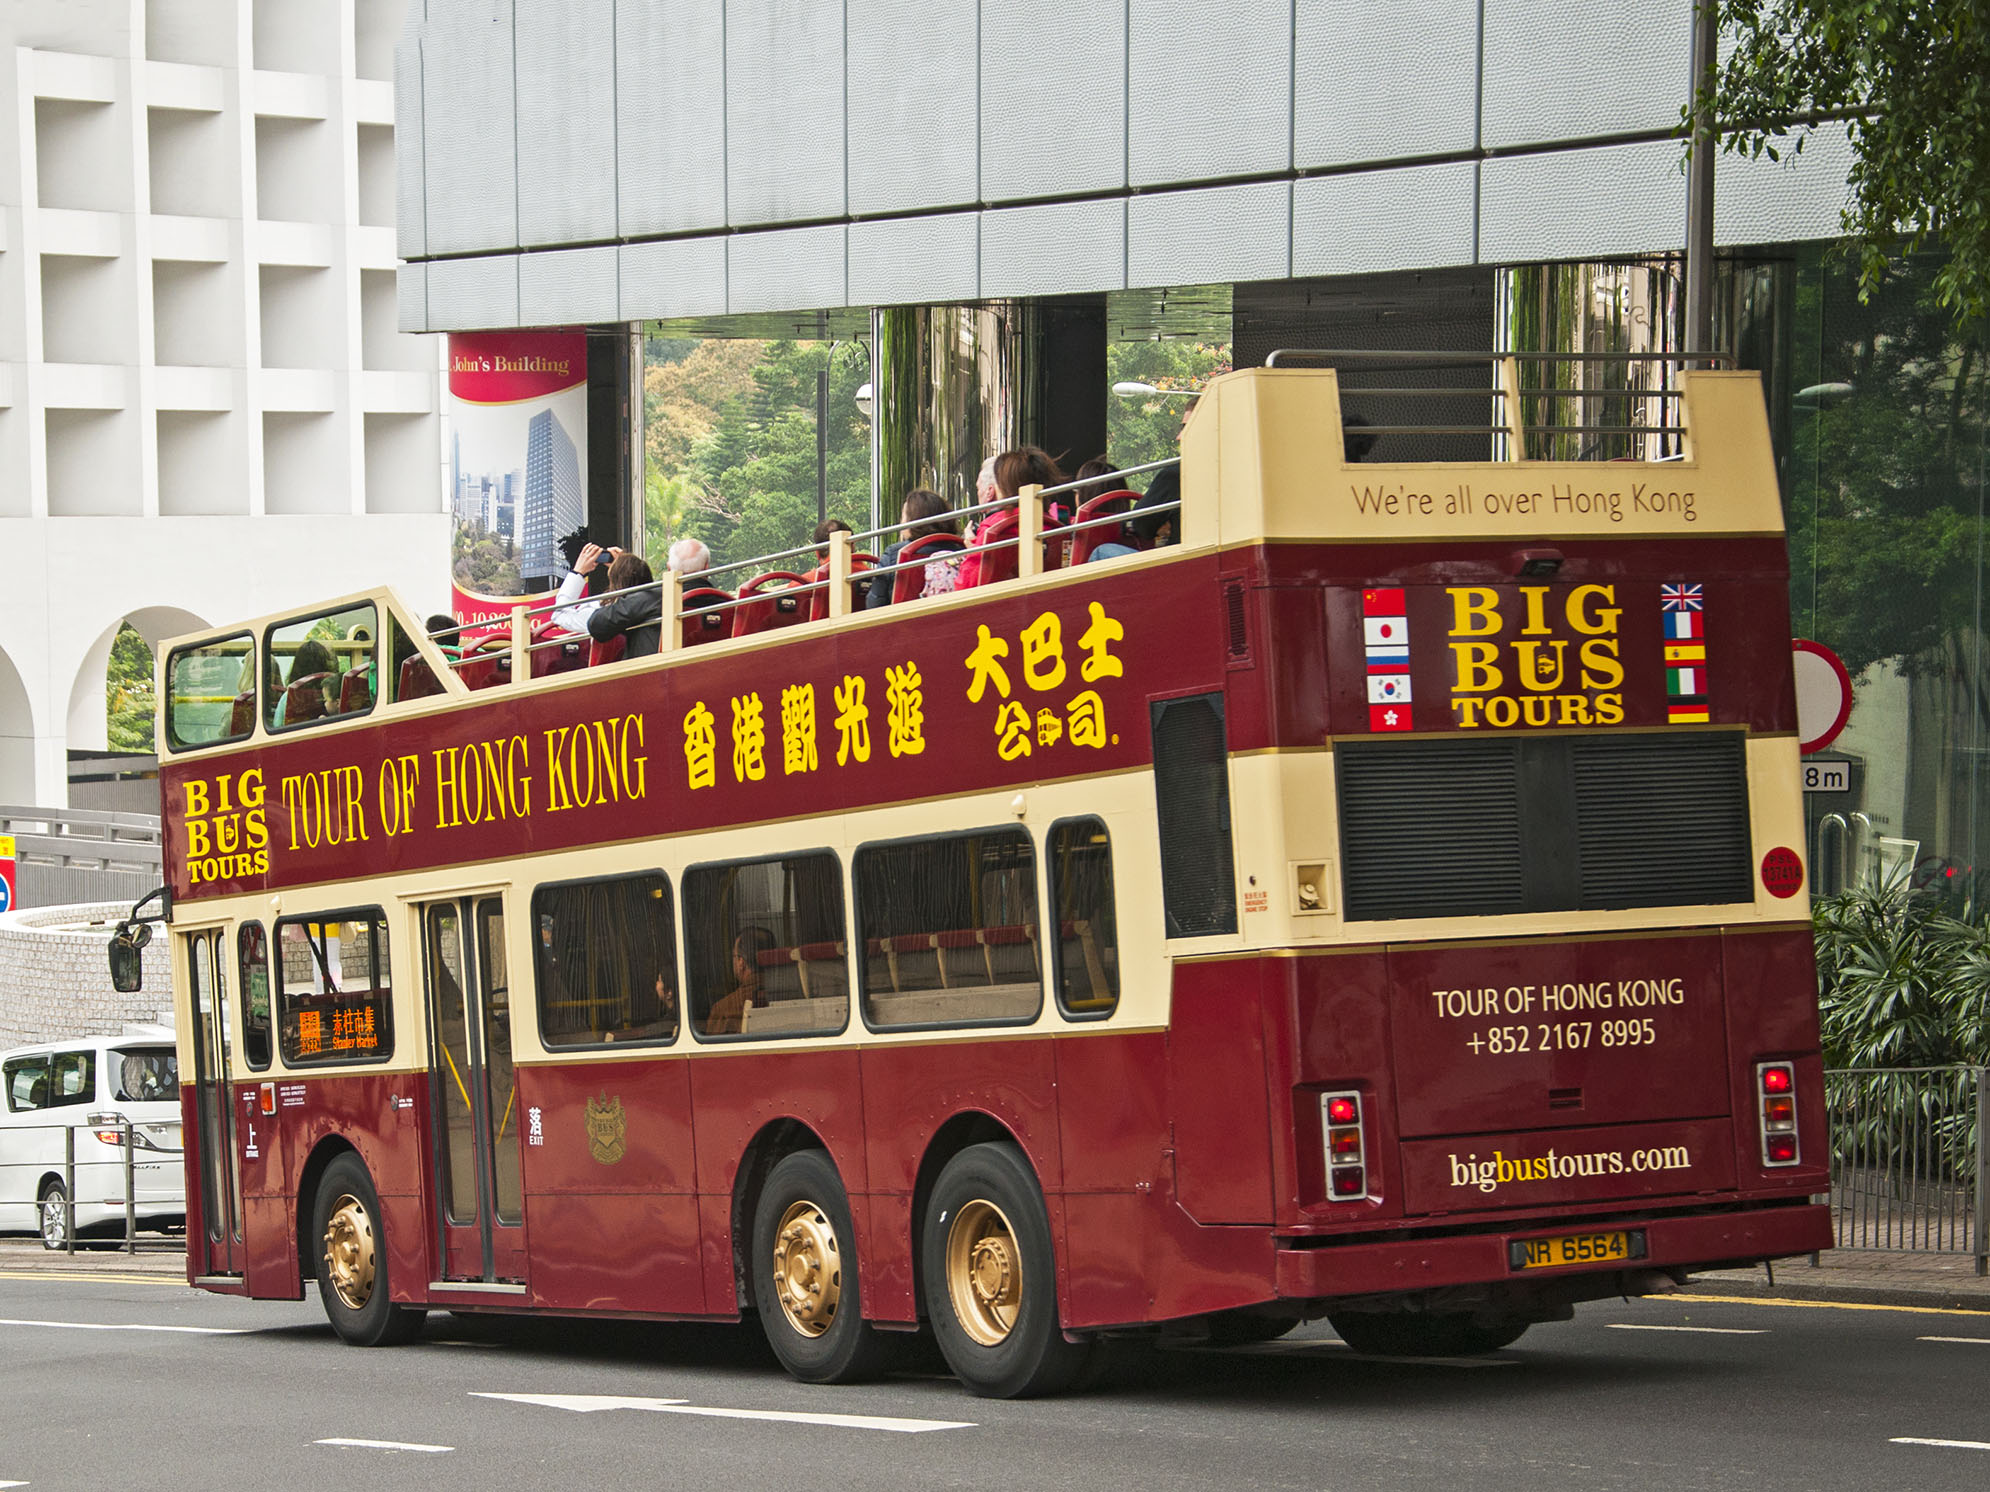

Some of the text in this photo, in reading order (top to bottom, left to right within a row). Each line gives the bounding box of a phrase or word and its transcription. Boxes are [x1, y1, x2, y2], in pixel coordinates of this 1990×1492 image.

[453, 355, 570, 376] John's Building
[1351, 483, 1698, 524] We're all over Hong Kong
[1445, 584, 1623, 637] BIG
[965, 601, 1124, 706] 大巴士
[1448, 638, 1624, 693] BUS
[1451, 693, 1625, 728] TOURS
[183, 768, 267, 818] BIG
[282, 713, 649, 851] TOUR OF HONG KONG
[185, 808, 269, 859] BUS
[187, 849, 270, 883] TOURS
[1432, 978, 1685, 1018] TOUR OF HONG KONG
[1466, 1018, 1656, 1055] +852 2167 8995
[529, 1135, 543, 1146] EXIT
[1448, 1146, 1692, 1193] bigbustours.com
[1524, 1234, 1623, 1265] NR 6564
